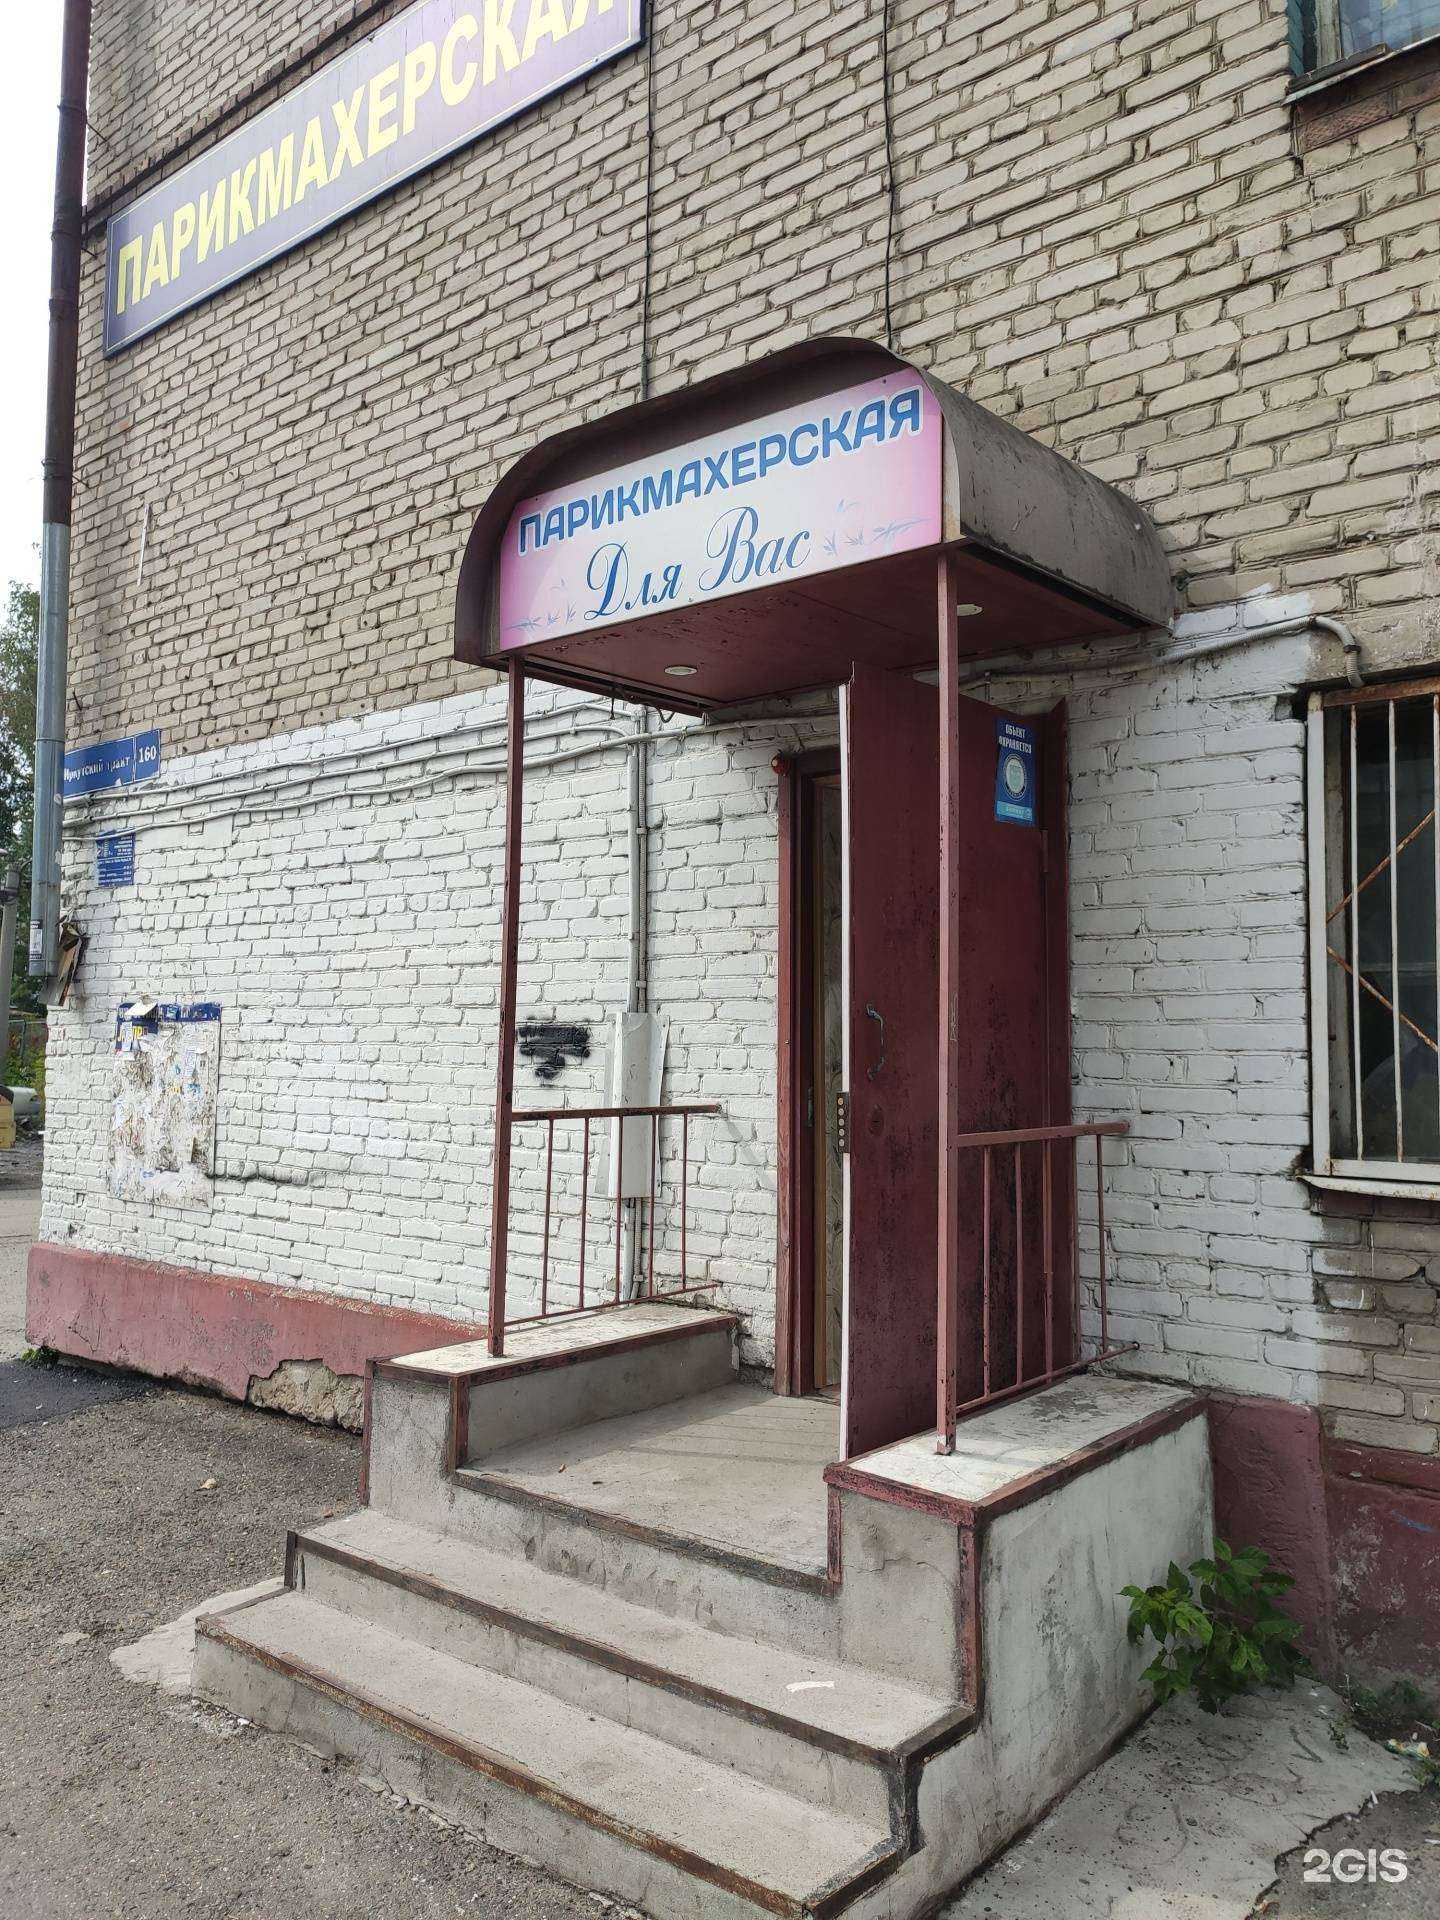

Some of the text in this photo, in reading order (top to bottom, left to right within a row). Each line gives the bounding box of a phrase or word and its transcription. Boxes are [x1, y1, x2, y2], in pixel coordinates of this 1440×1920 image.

[115, 0, 613, 315] ПАРИКМАХЕРСКА
[519, 388, 921, 553] ПАРИКМАХЕРСКАЯ
[583, 506, 811, 621] Для Вас
[138, 745, 158, 764] 160
[1005, 724, 1025, 738] ОБЪЕКТ
